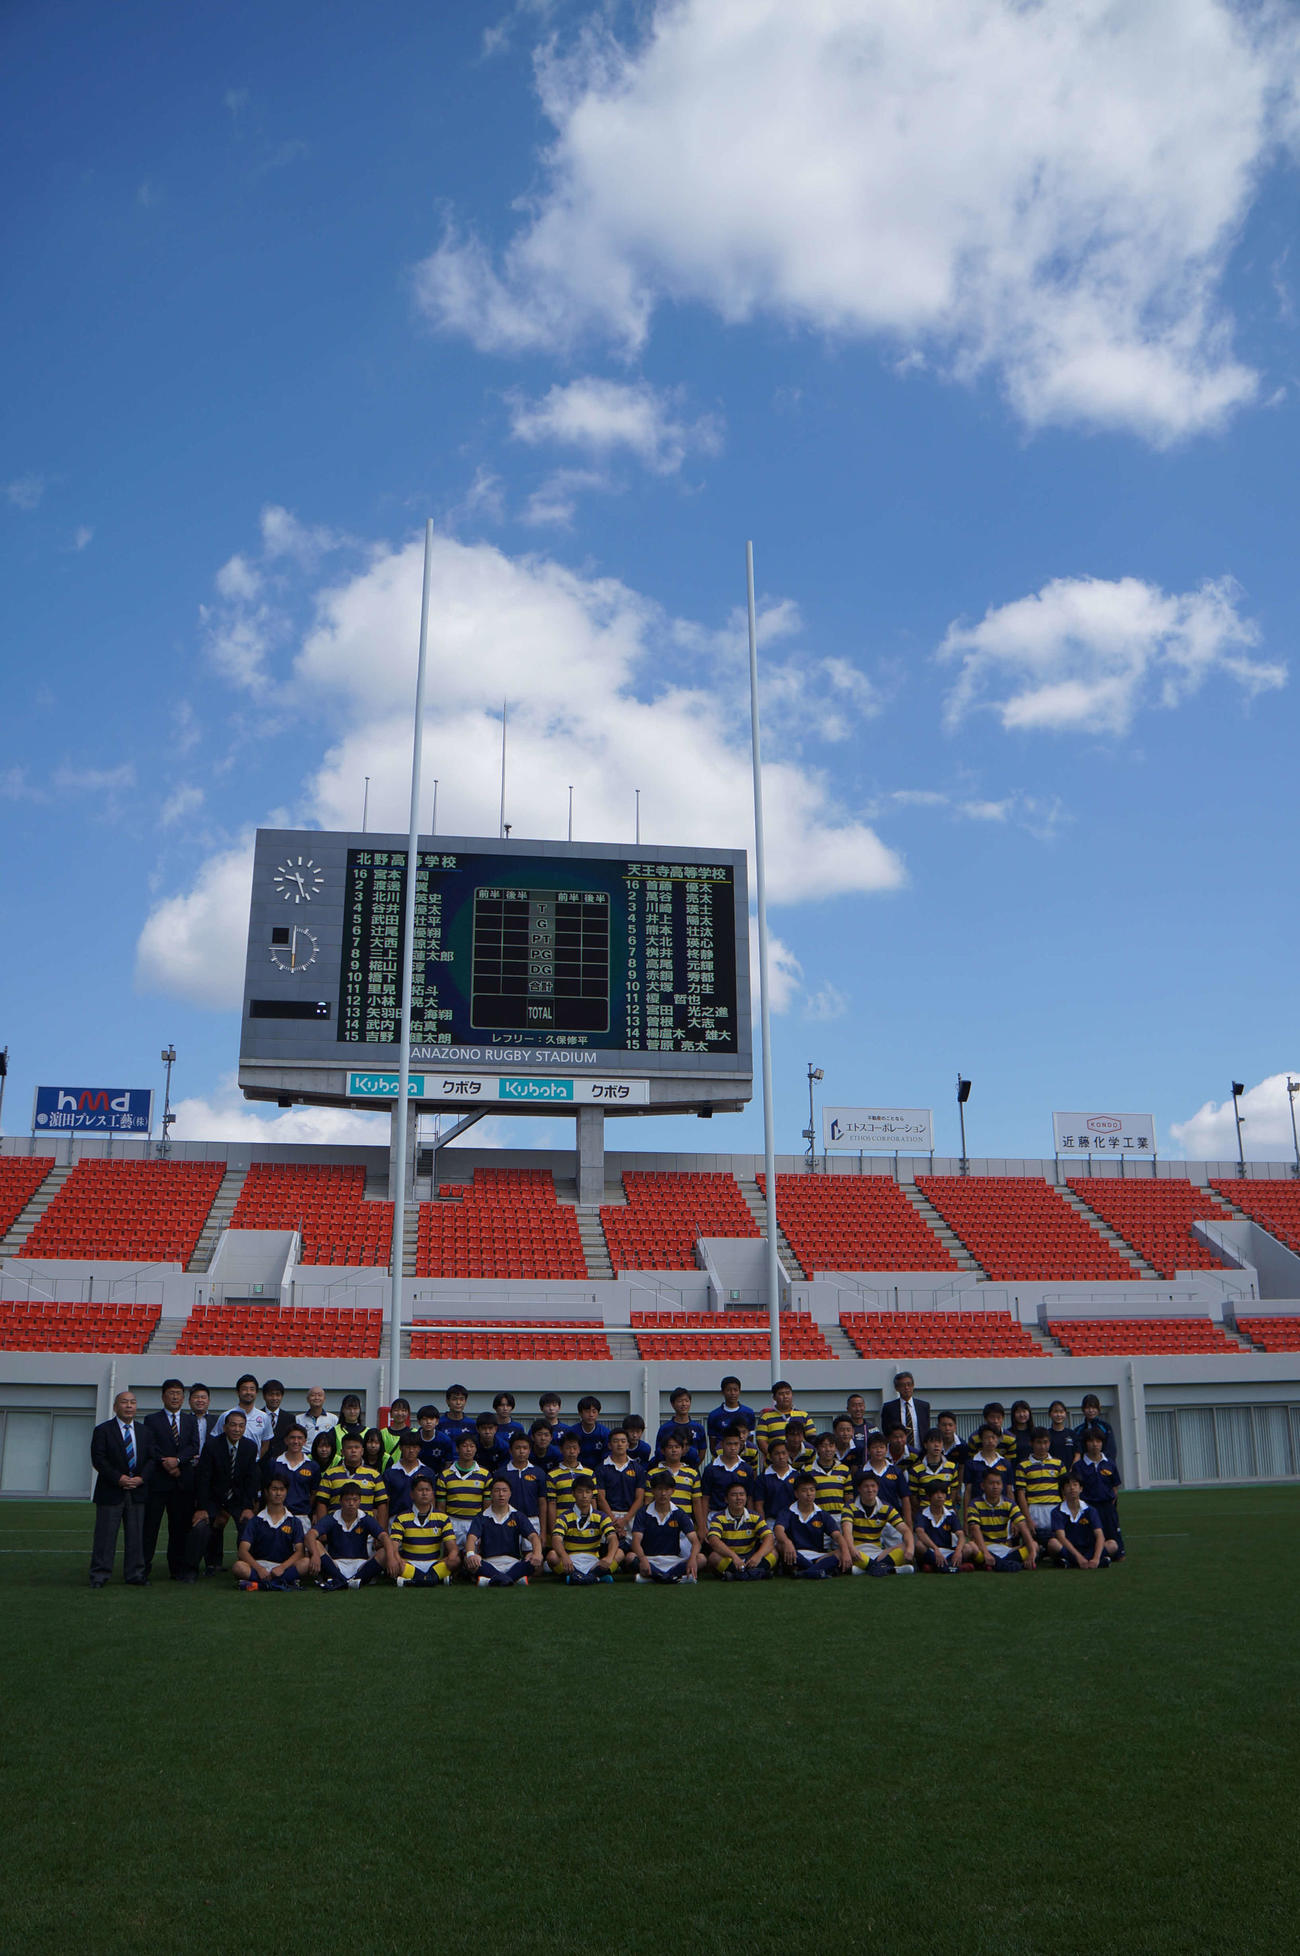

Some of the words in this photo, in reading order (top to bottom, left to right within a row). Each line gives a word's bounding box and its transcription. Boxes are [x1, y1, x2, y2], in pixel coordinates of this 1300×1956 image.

[354, 870, 368, 878] 16
[374, 870, 402, 880] 宮本
[628, 864, 726, 880] 天王寺高等学校
[355, 881, 364, 890] 2
[626, 881, 639, 889] 16
[354, 892, 364, 901] 3
[372, 892, 400, 902] 北川
[415, 894, 442, 904] 英史
[478, 890, 500, 899] 前半
[506, 890, 528, 900] 後半
[558, 893, 579, 902] 前半
[628, 892, 636, 900] 2
[353, 904, 362, 912] 4
[372, 904, 400, 914] 谷井
[538, 904, 547, 913] T
[628, 903, 636, 911] 3
[353, 915, 362, 924] 5
[371, 915, 399, 926] 武田
[414, 916, 441, 927] 壮平
[537, 919, 548, 929] G
[628, 914, 636, 922] 4
[646, 914, 672, 925] 井上
[353, 926, 361, 935] 6
[371, 926, 399, 937] 辻尾
[628, 925, 636, 934] 5
[646, 925, 672, 935] 熊本
[353, 938, 361, 946] 7
[370, 938, 398, 948] 大西
[532, 935, 551, 944] PT
[628, 936, 636, 945] 6
[646, 936, 672, 946] 大北
[351, 949, 360, 958] 8
[369, 949, 397, 960] 三上
[531, 950, 552, 959] PG
[628, 948, 636, 956] 7
[351, 961, 359, 970] 9
[531, 965, 552, 975] DG
[628, 959, 636, 968] 8
[646, 959, 672, 970] 高尾
[348, 973, 362, 982] 10
[628, 971, 636, 979] 9
[687, 972, 714, 982] 秀都
[347, 984, 360, 993] 11
[368, 984, 396, 995] 里見
[529, 981, 553, 992] 合計
[626, 982, 640, 991] 10
[688, 984, 714, 994] 力生
[347, 996, 360, 1005] 12
[368, 996, 395, 1007] 小林
[626, 994, 638, 1002] 11
[674, 994, 700, 1005] 哲也
[346, 1008, 360, 1017] 13
[424, 1009, 453, 1020] 海翔
[528, 1006, 552, 1019] TOTAL
[626, 1005, 640, 1014] 12
[345, 1020, 359, 1029] 14
[366, 1020, 394, 1030] 武内
[626, 1017, 640, 1026] 13
[688, 1018, 715, 1028] 大志
[345, 1032, 359, 1041] 15
[366, 1032, 394, 1043] 吉野
[626, 1028, 640, 1037] 14
[705, 1030, 731, 1041] 雄大
[626, 1040, 640, 1049] 15
[681, 1041, 708, 1051] 亮太
[411, 1048, 481, 1061] ANAZONO
[486, 1049, 531, 1062] RUGBY
[536, 1050, 597, 1064] STADIUM
[355, 1077, 417, 1093] Kuboa
[443, 1080, 482, 1094] クボタ
[506, 1081, 567, 1097] Kubota
[591, 1084, 630, 1098] クボタ
[846, 1123, 926, 1134] エトスコーポレーション
[1062, 1136, 1149, 1149] 近藤化学工業
